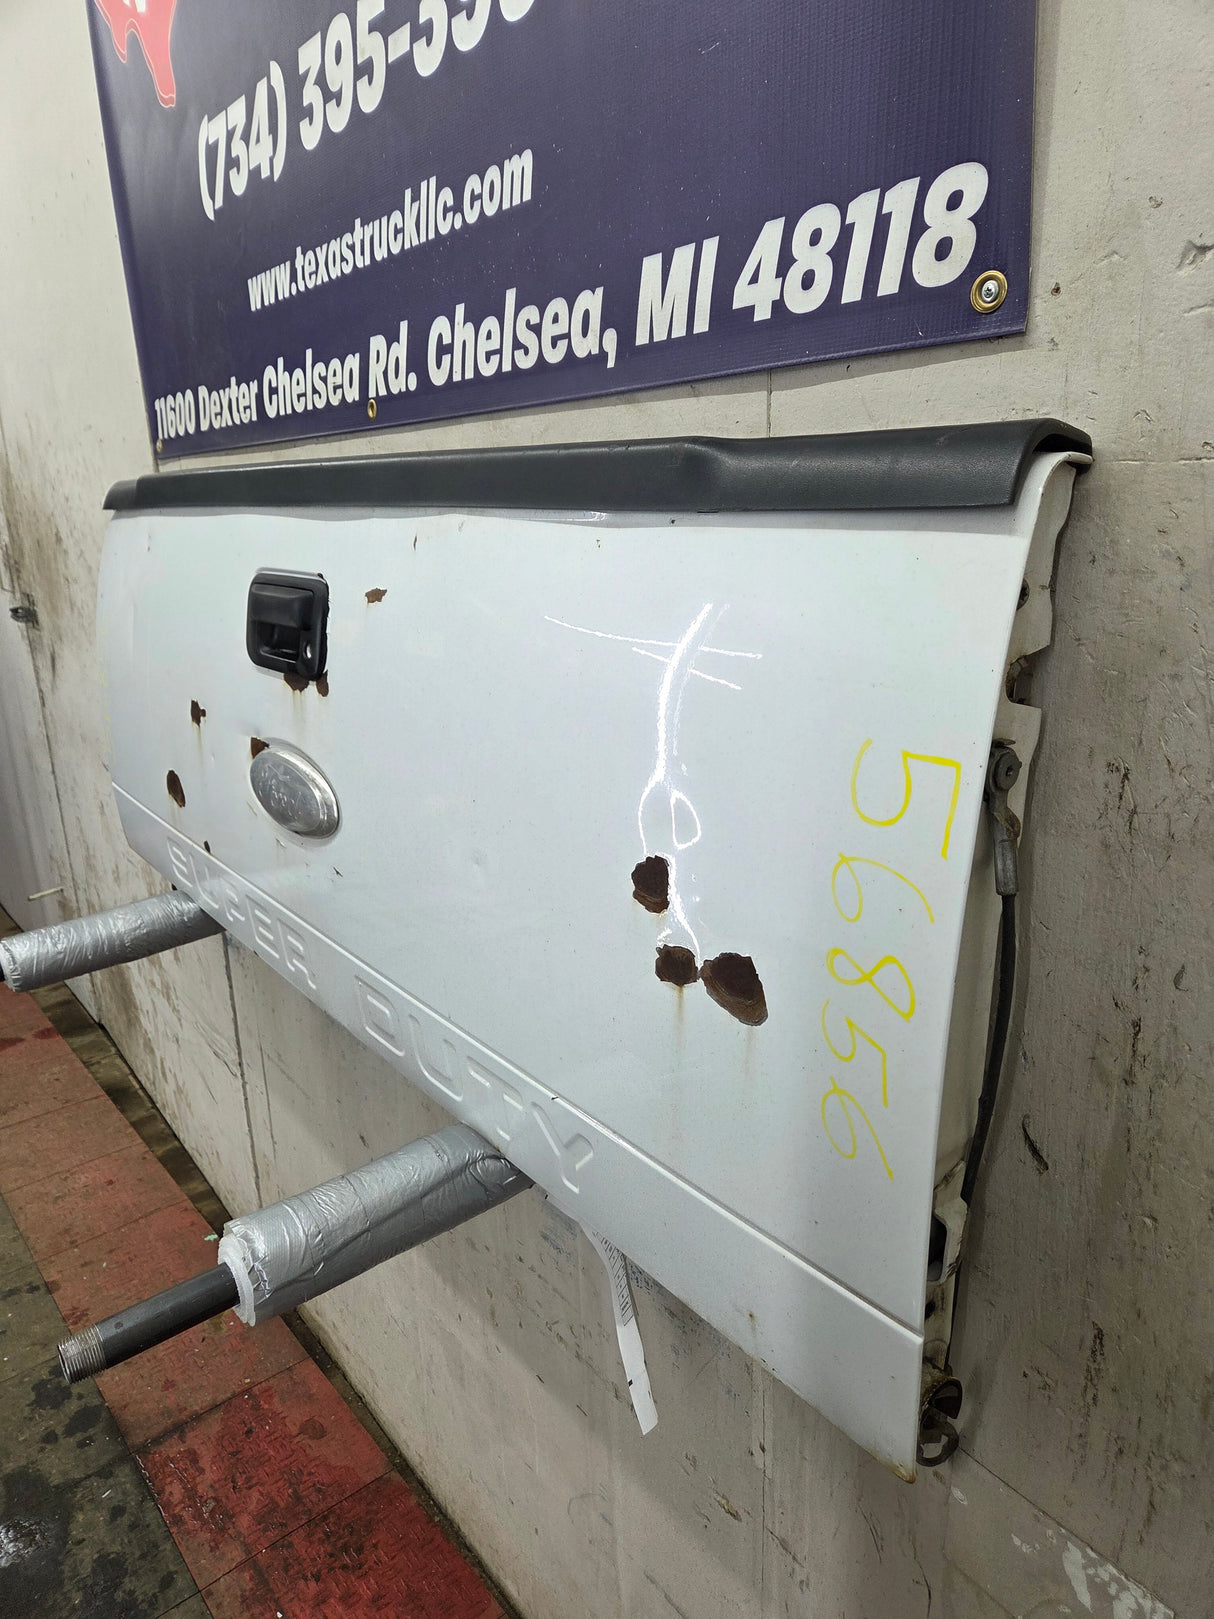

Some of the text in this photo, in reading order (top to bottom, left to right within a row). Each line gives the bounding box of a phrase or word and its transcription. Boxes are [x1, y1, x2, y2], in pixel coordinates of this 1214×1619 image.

[198, 60, 287, 221] (734)
[247, 148, 533, 312] www.texastruckllc.com
[154, 161, 989, 441] 11600 Dexter Chelsea Rd. Chelsea, MI 48118
[166, 835, 595, 1195] SUPER DUTY
